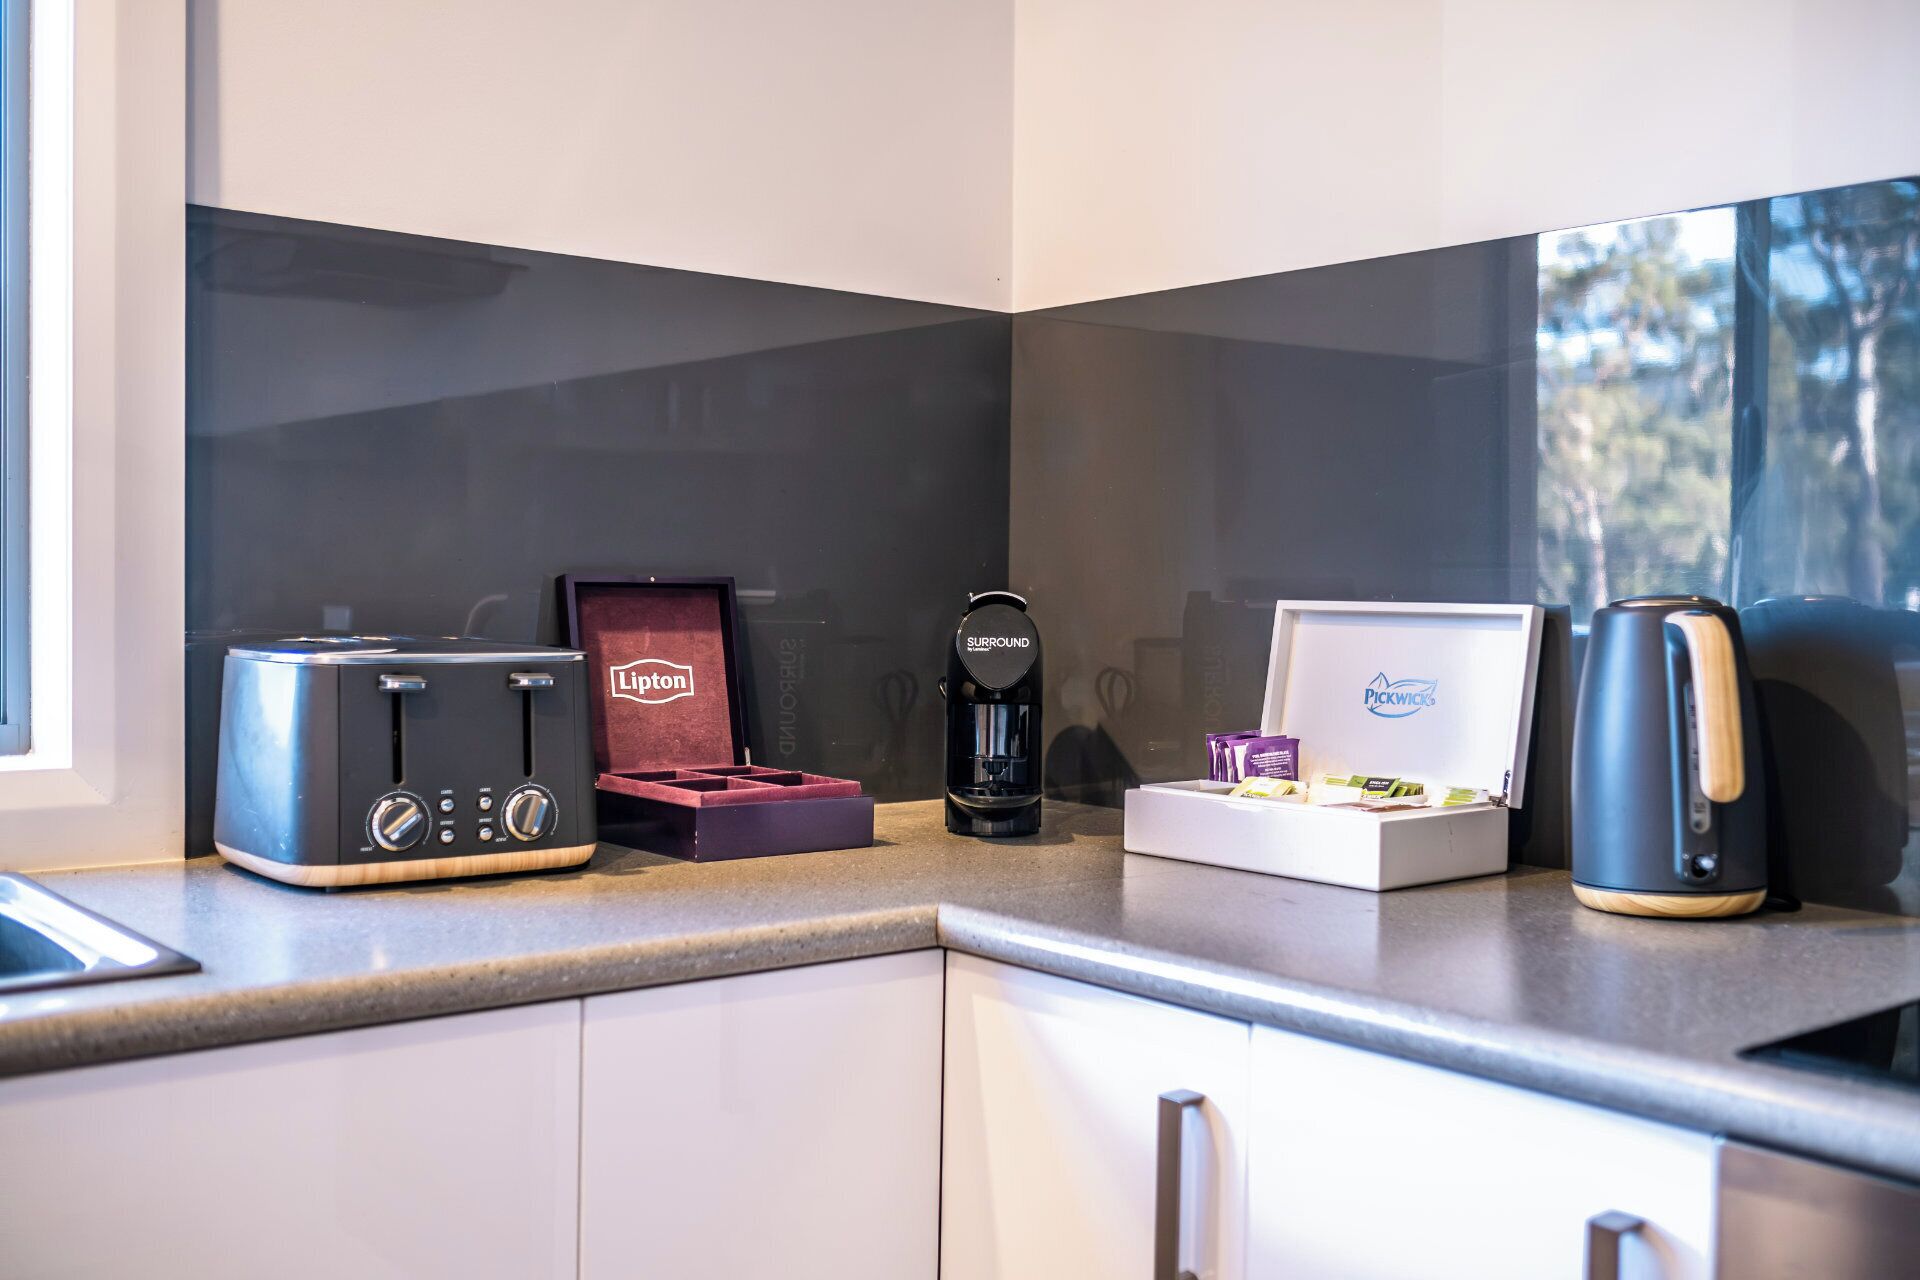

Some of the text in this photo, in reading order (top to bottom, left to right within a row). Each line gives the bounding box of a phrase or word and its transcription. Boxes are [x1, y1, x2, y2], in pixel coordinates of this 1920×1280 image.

[967, 637, 1030, 648] SURROUND
[619, 671, 687, 695] Lipton
[1364, 688, 1428, 706] PICKWICK
